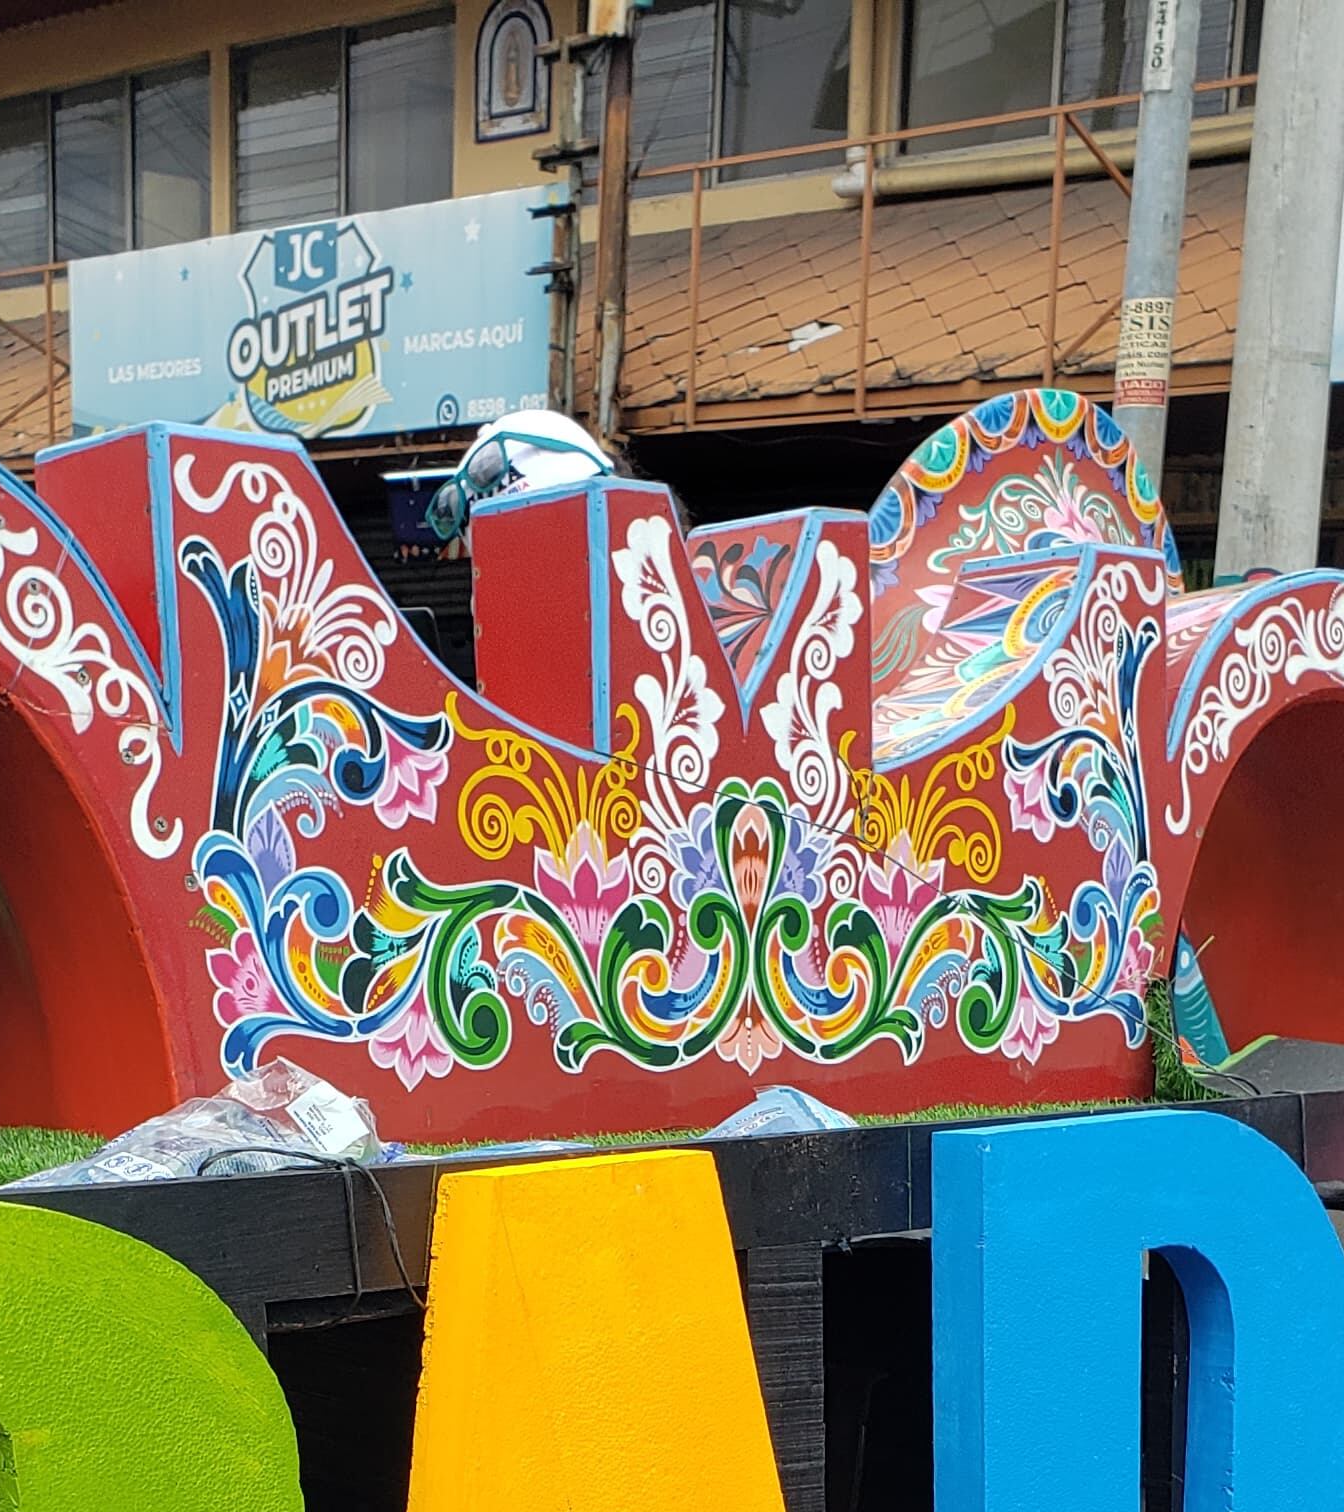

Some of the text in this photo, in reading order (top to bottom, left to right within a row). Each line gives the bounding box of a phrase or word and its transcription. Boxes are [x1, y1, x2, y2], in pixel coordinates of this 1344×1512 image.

[287, 230, 325, 282] JC
[228, 272, 392, 379] OUTLET
[403, 317, 525, 355] MARCAS AQUÍ
[107, 357, 202, 384] LAS MEJORES
[266, 351, 355, 402] PREMIUM
